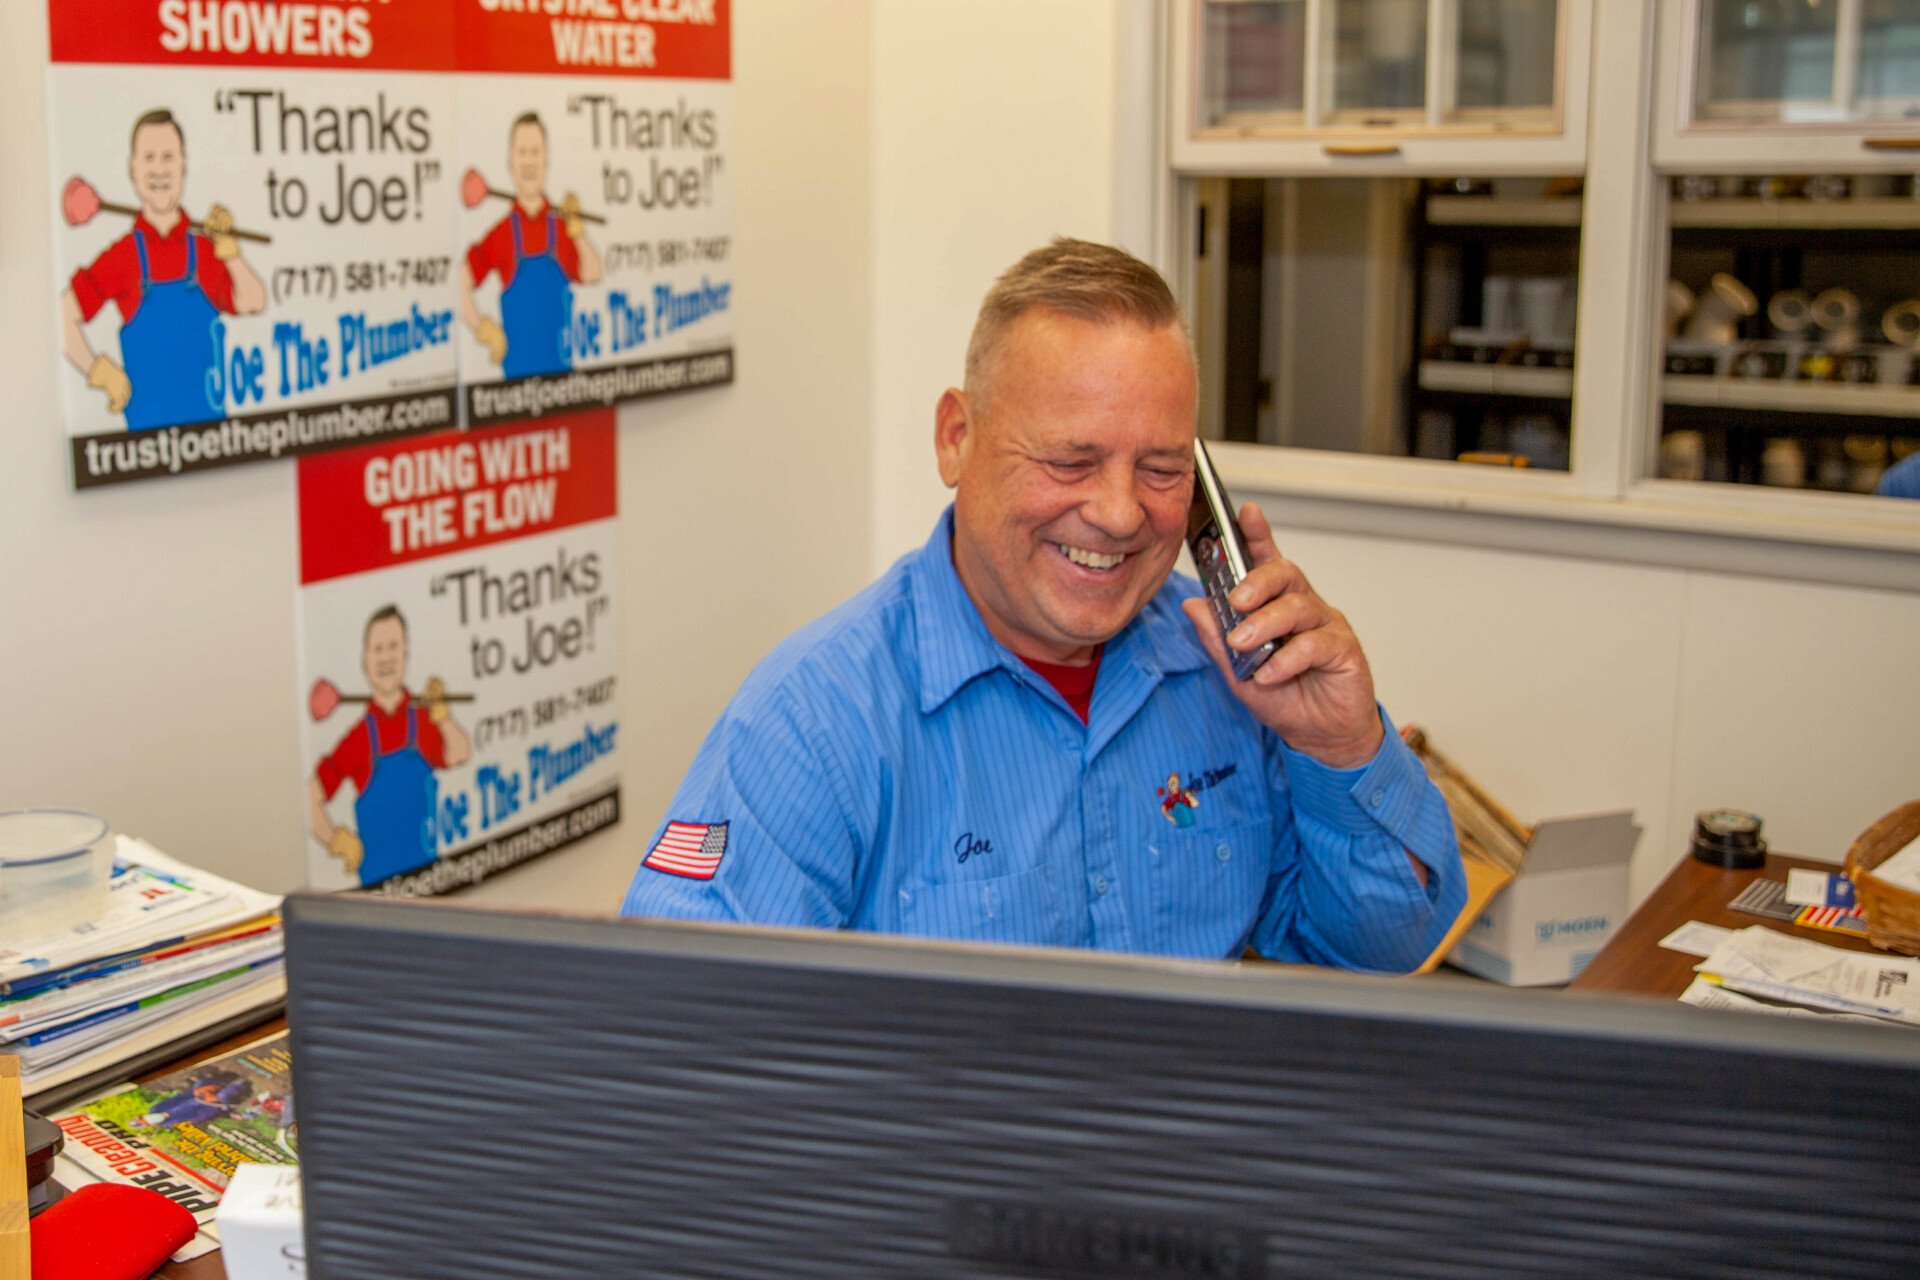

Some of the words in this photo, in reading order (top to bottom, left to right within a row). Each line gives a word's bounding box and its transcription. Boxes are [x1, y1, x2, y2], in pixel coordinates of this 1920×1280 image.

[158, 0, 373, 57] SHOWERS
[551, 18, 656, 67] WATER
[214, 89, 432, 154] “Thanks
[567, 95, 717, 151] “Thanks
[266, 168, 308, 219] to
[318, 161, 441, 226] Joe!”
[603, 160, 633, 206] to
[639, 155, 723, 210] Joe!”
[272, 264, 337, 306] (717)
[345, 256, 451, 291] 581-7407
[558, 285, 602, 366] Joe
[608, 290, 646, 353] The
[652, 276, 731, 339] Plumber
[204, 314, 266, 412] Joe
[273, 322, 329, 396] The
[338, 301, 454, 380] Plumber
[473, 356, 727, 417] trustjoetheplumber.com
[85, 395, 449, 476] trustjoetheplumber.com
[364, 451, 478, 506] GOING
[481, 427, 570, 477] WITH
[382, 495, 458, 554] THE
[463, 479, 558, 539] FLOW
[429, 544, 602, 627] “Thanks
[471, 634, 505, 679] to
[512, 595, 610, 675] Joe!”
[474, 707, 529, 752] (717)
[420, 772, 470, 858] Joe
[476, 766, 520, 830] The
[528, 721, 617, 803] Plumber
[955, 832, 994, 864] Joe
[95, 1120, 151, 1149] PRO
[196, 1148, 238, 1180] erving
